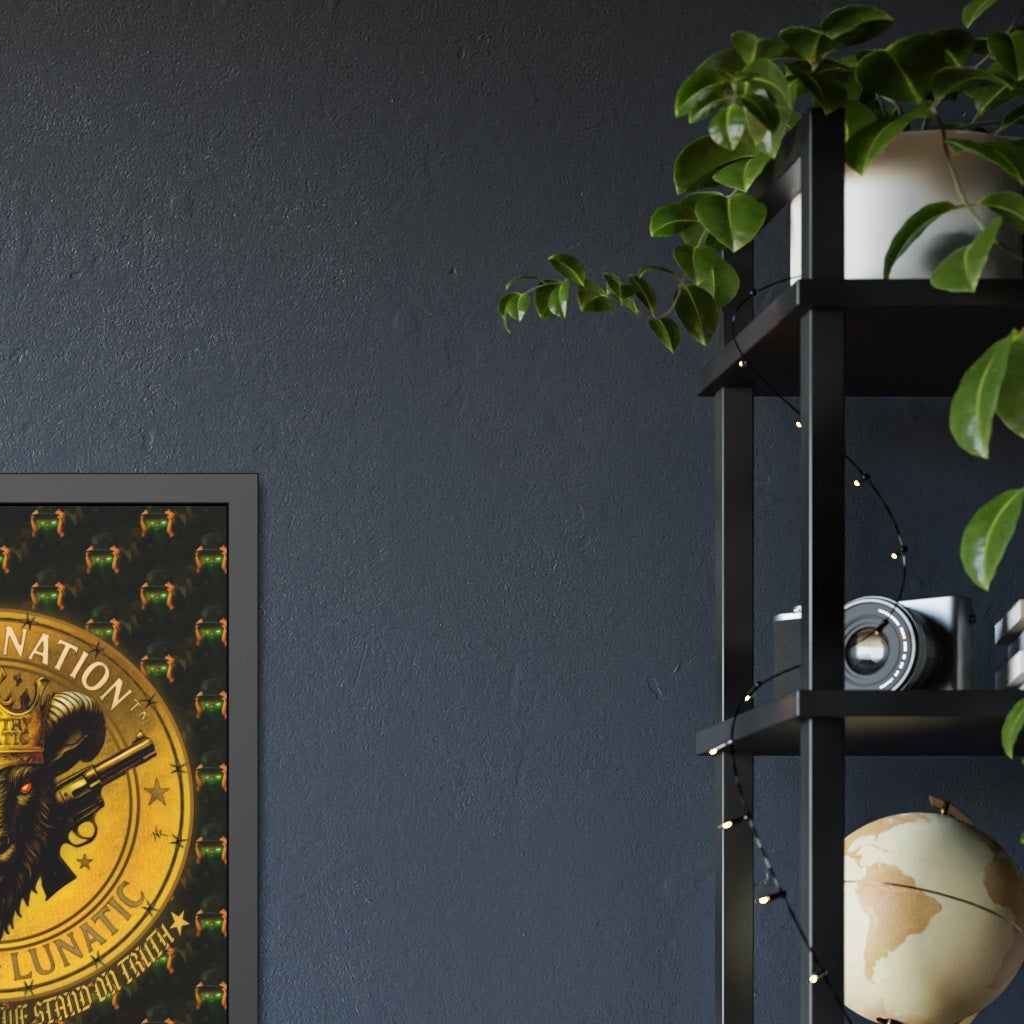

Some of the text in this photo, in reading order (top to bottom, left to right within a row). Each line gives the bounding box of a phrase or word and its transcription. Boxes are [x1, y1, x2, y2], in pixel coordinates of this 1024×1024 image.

[10, 880, 145, 981] LUNATIC
[94, 969, 121, 1002] ON
[117, 923, 175, 985] TRUTH
